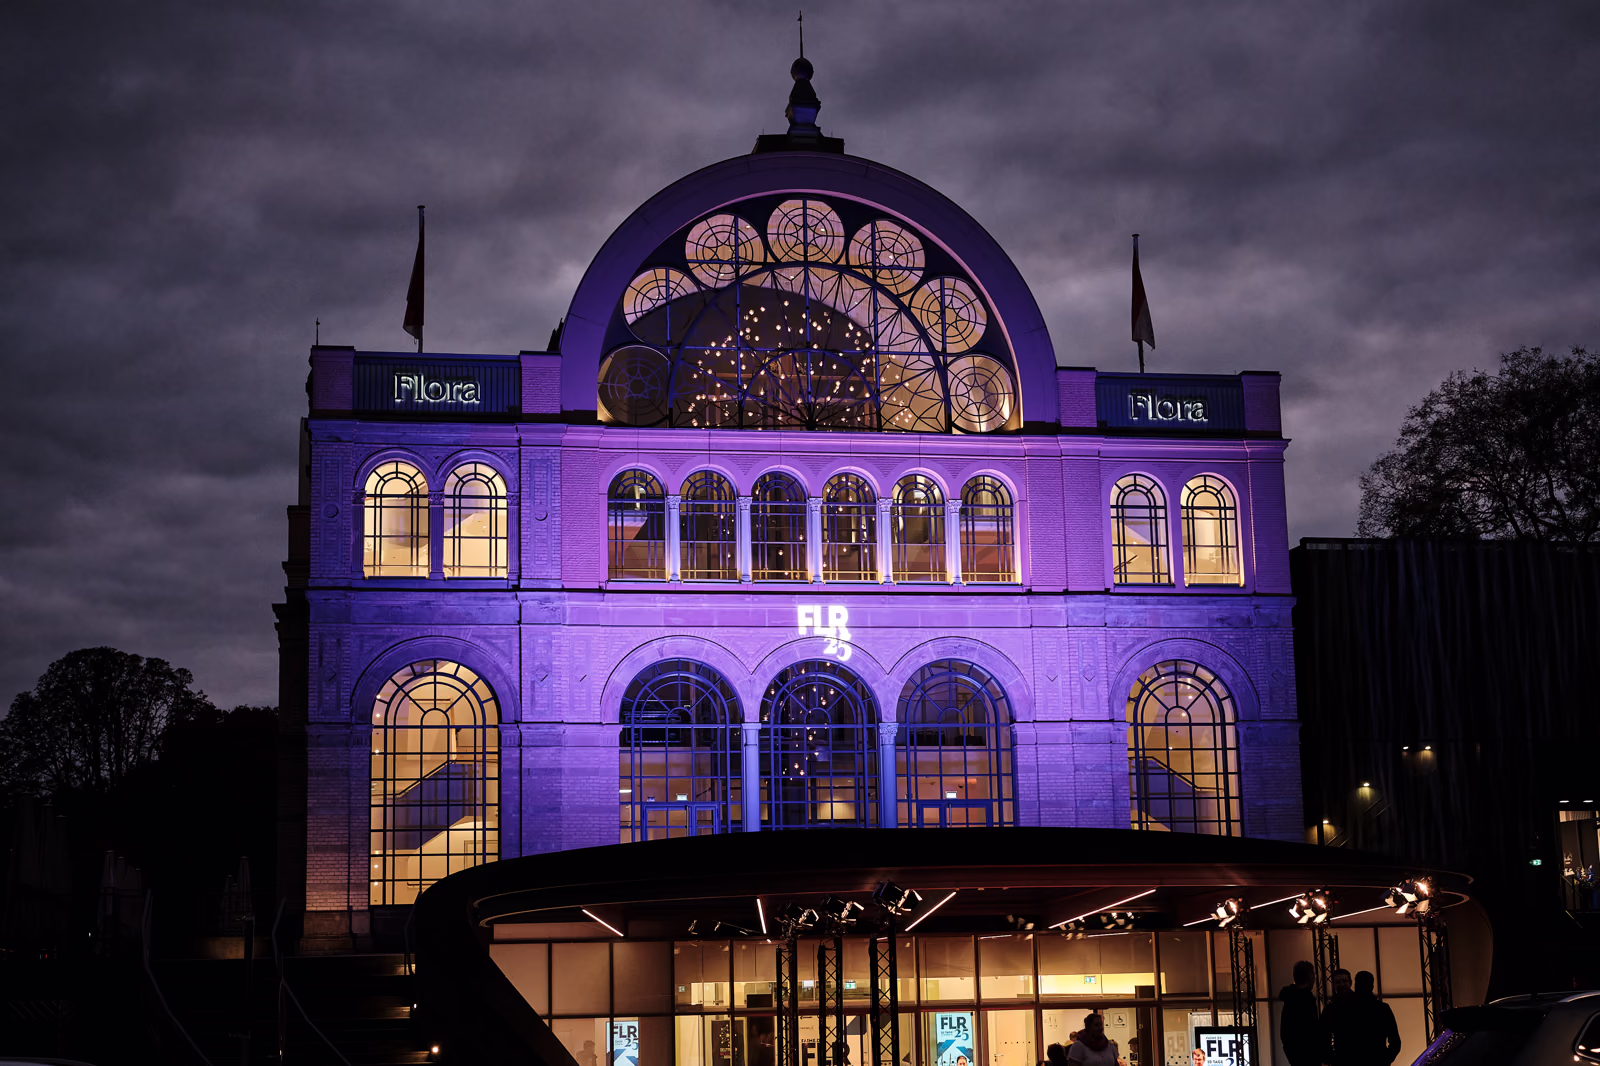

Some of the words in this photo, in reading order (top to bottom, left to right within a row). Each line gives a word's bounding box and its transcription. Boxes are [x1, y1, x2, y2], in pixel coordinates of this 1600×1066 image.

[393, 372, 480, 404] Flora
[1128, 392, 1209, 422] Flora
[797, 605, 852, 641] FLR
[823, 635, 852, 662] 25
[941, 1016, 967, 1029] FLR
[954, 1028, 969, 1041] 25
[624, 1038, 639, 1051] 25
